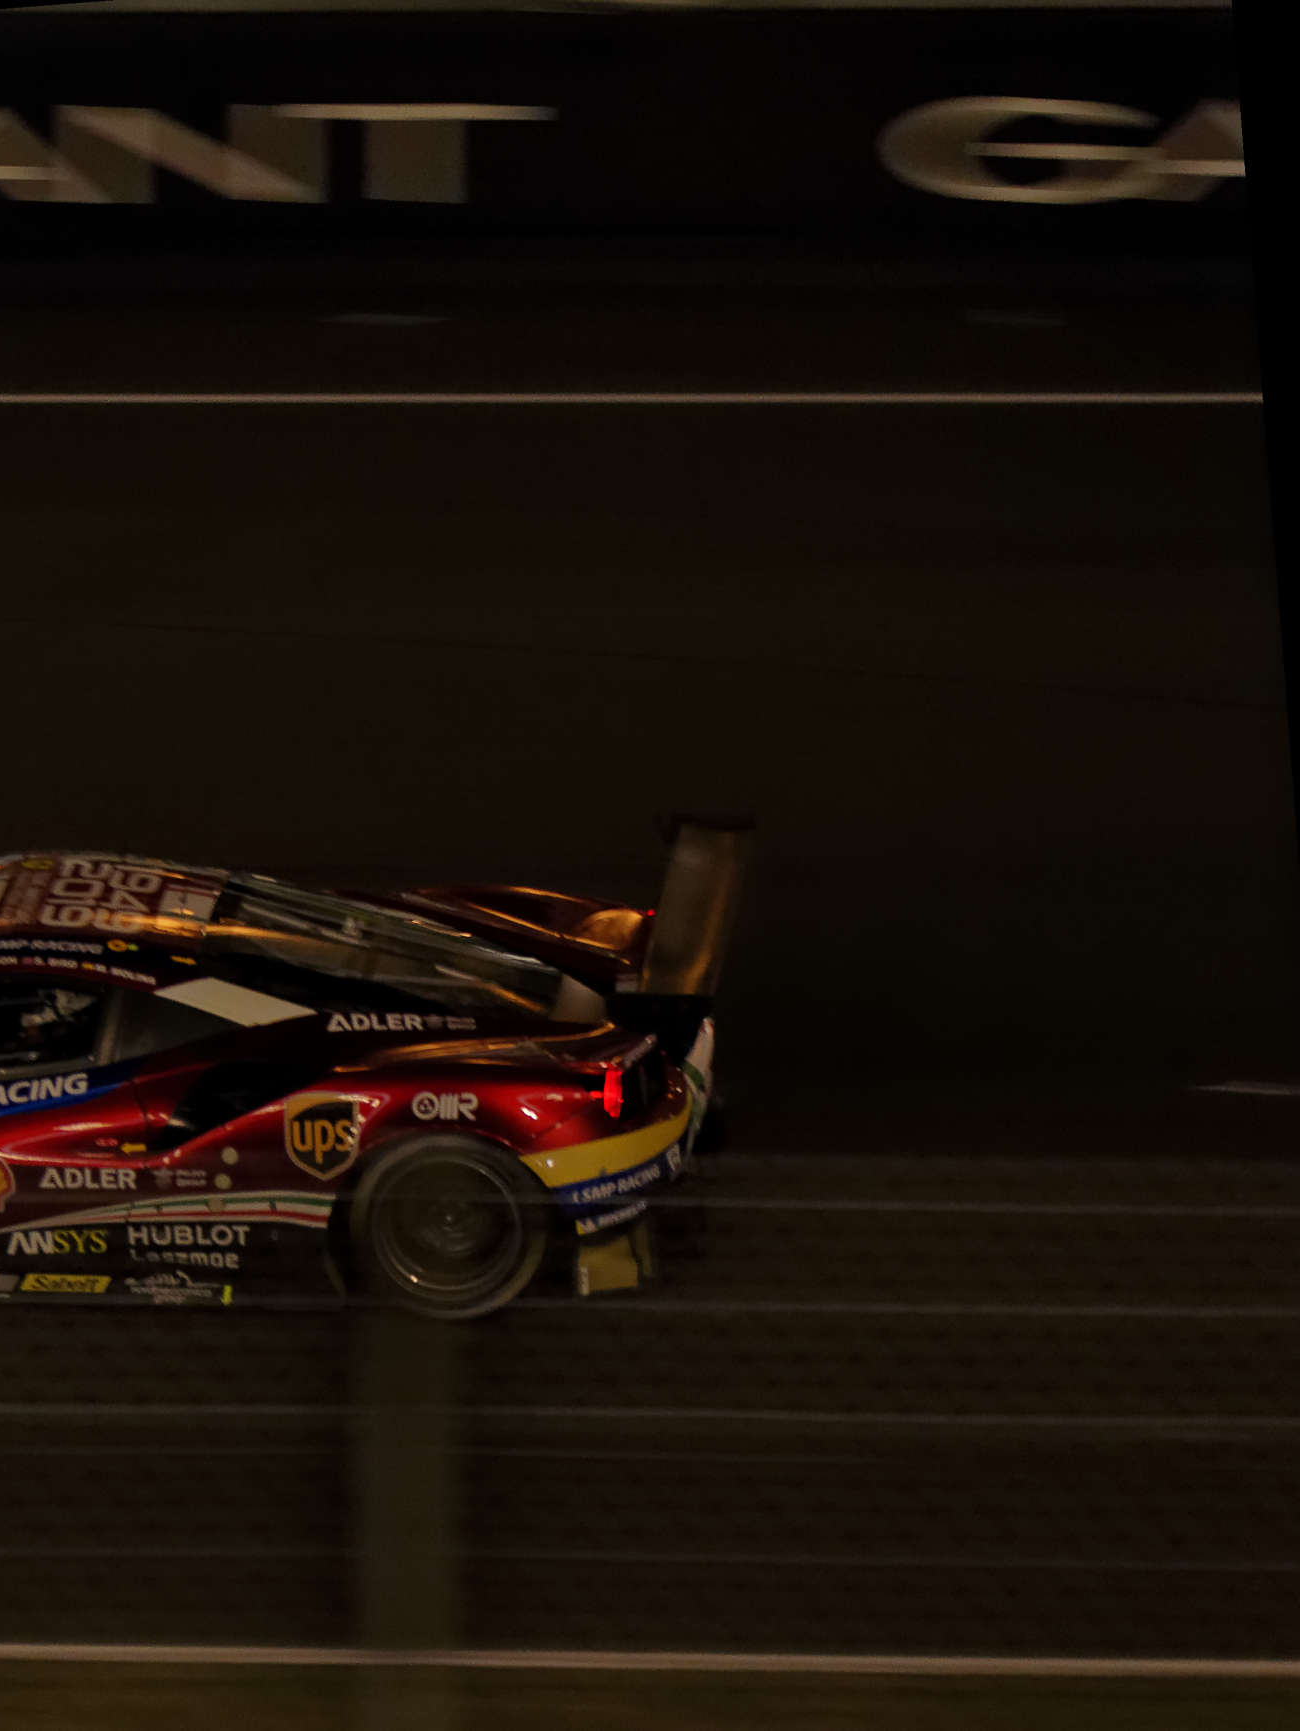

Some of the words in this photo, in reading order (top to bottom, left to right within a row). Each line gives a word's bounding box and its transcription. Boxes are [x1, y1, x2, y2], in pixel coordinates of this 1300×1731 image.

[325, 1011, 425, 1033] ADLER
[292, 1119, 353, 1165] ups
[38, 1167, 138, 1190] ADLER
[6, 1229, 109, 1257] ANSYS
[126, 1224, 250, 1247] HUBLOT
